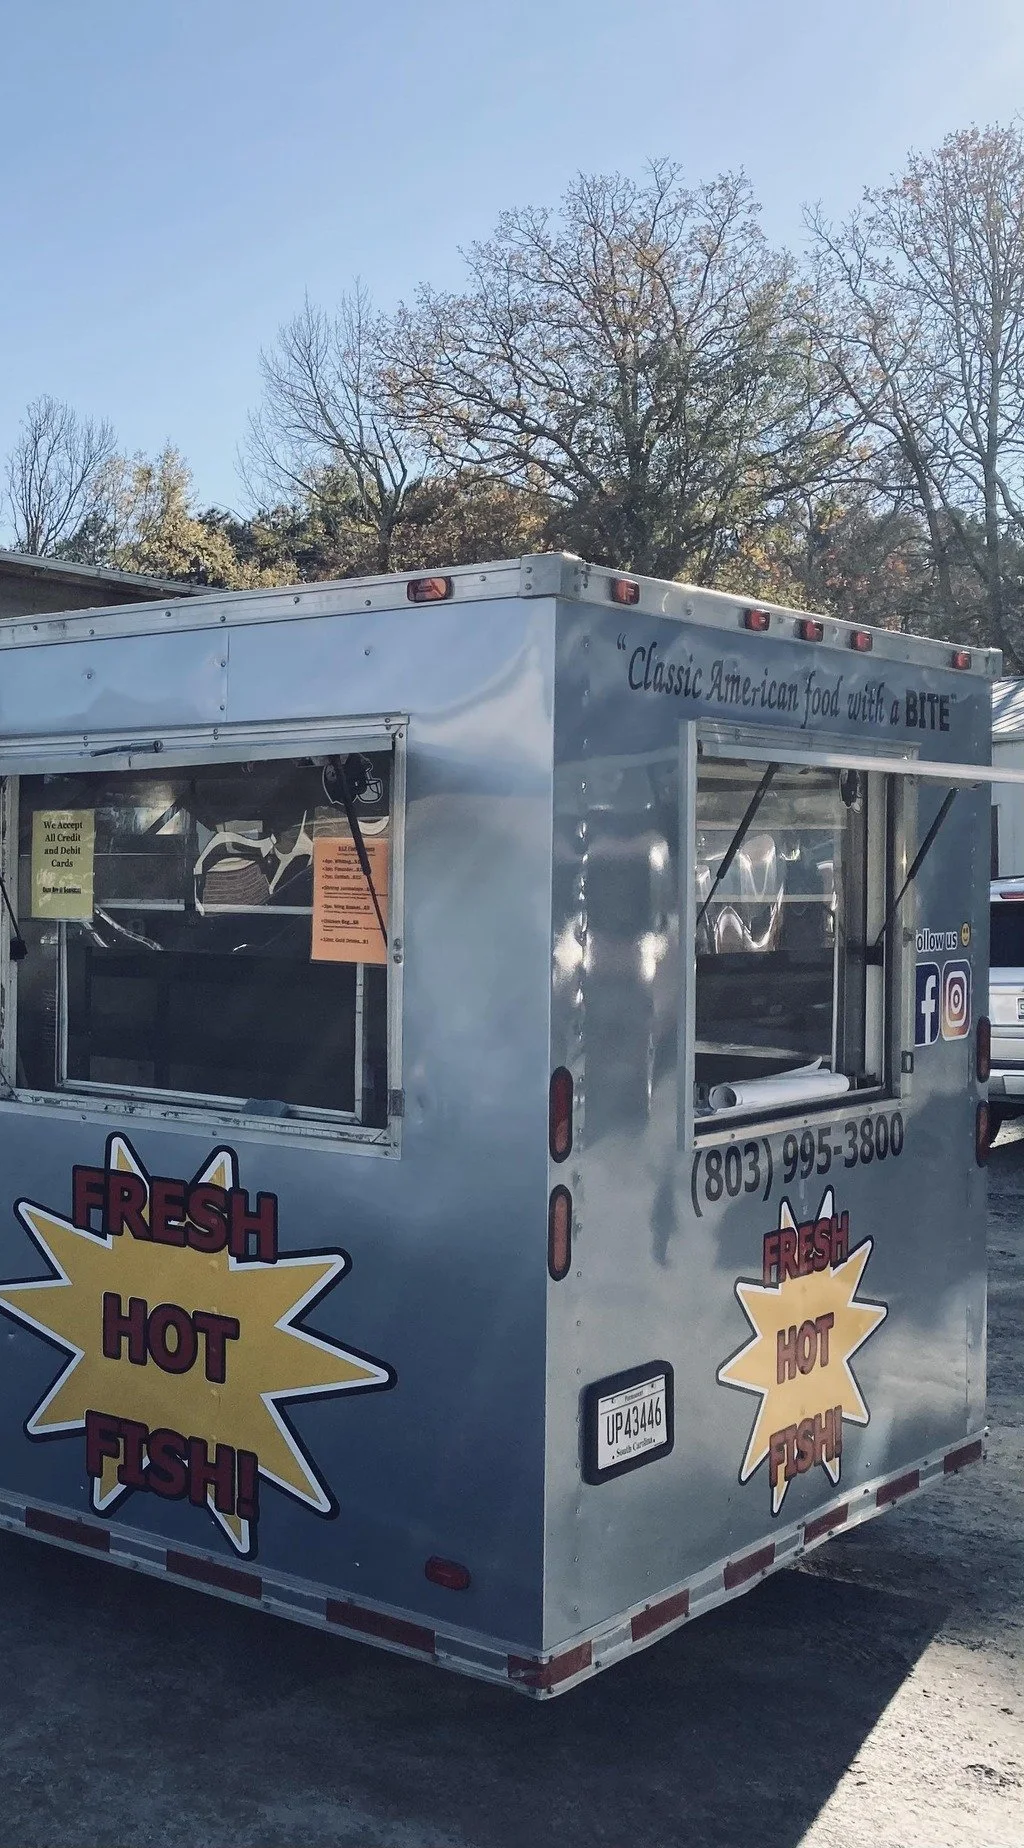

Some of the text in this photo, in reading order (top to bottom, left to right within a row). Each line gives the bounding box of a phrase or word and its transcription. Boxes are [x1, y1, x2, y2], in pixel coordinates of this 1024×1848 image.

[706, 659, 798, 712] American
[801, 670, 843, 728] food
[848, 682, 885, 722] with
[890, 700, 899, 725] a
[44, 821, 82, 830] We Accept
[44, 847, 81, 855] and Debit
[45, 834, 55, 842] All
[916, 928, 958, 953] ollow us
[691, 1112, 905, 1217] (803) 995-3800
[72, 1164, 278, 1264] FRESH
[763, 1210, 850, 1289] FRESH
[102, 1292, 240, 1384] HOT
[776, 1312, 834, 1385] HOT
[607, 1397, 661, 1446] UP43446
[617, 1437, 652, 1457] South Carolina
[768, 1405, 843, 1488] FISH!
[85, 1409, 259, 1521] FISH!
